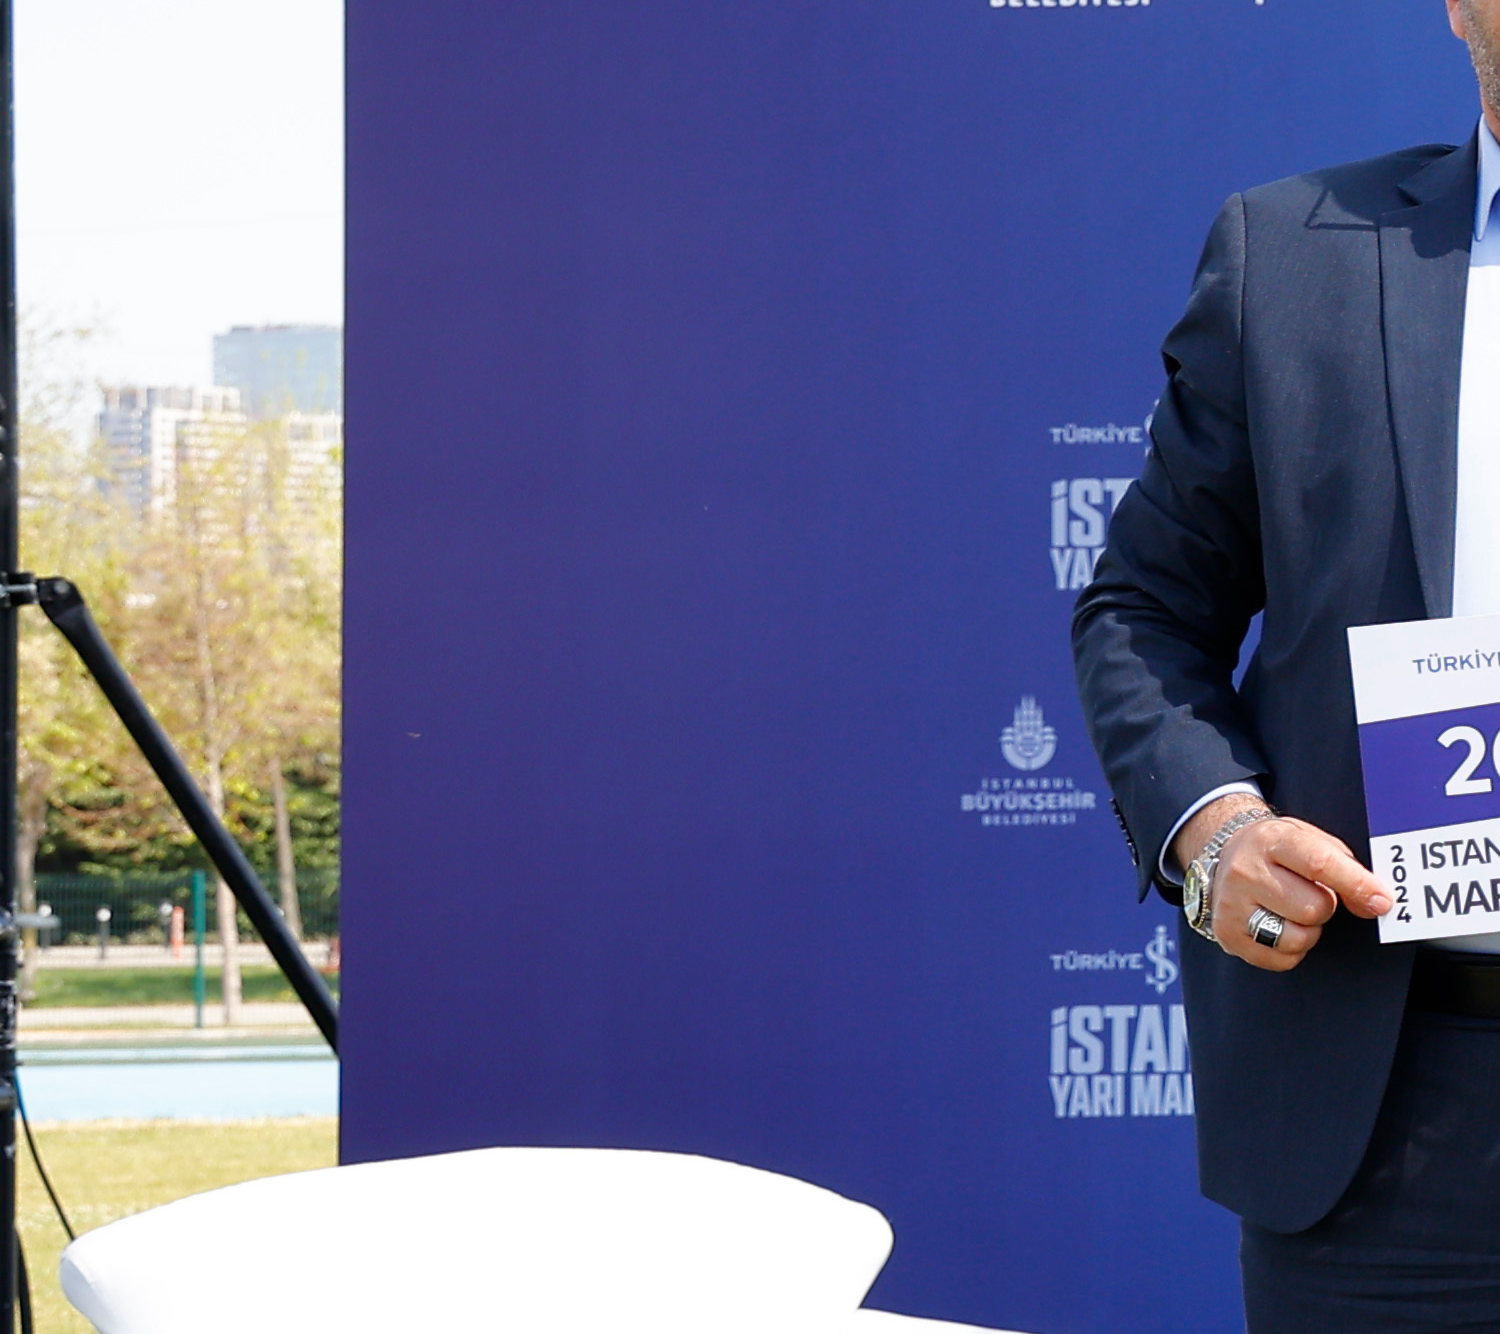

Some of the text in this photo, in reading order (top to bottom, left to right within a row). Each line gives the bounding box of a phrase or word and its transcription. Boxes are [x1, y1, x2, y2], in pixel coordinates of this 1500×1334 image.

[1049, 423, 1143, 444] TÜRKİYE
[961, 789, 1096, 811] BÜYÜKŞEHİR
[1050, 949, 1144, 970] TÜRKİYE
[1049, 1074, 1125, 1117] YARI
